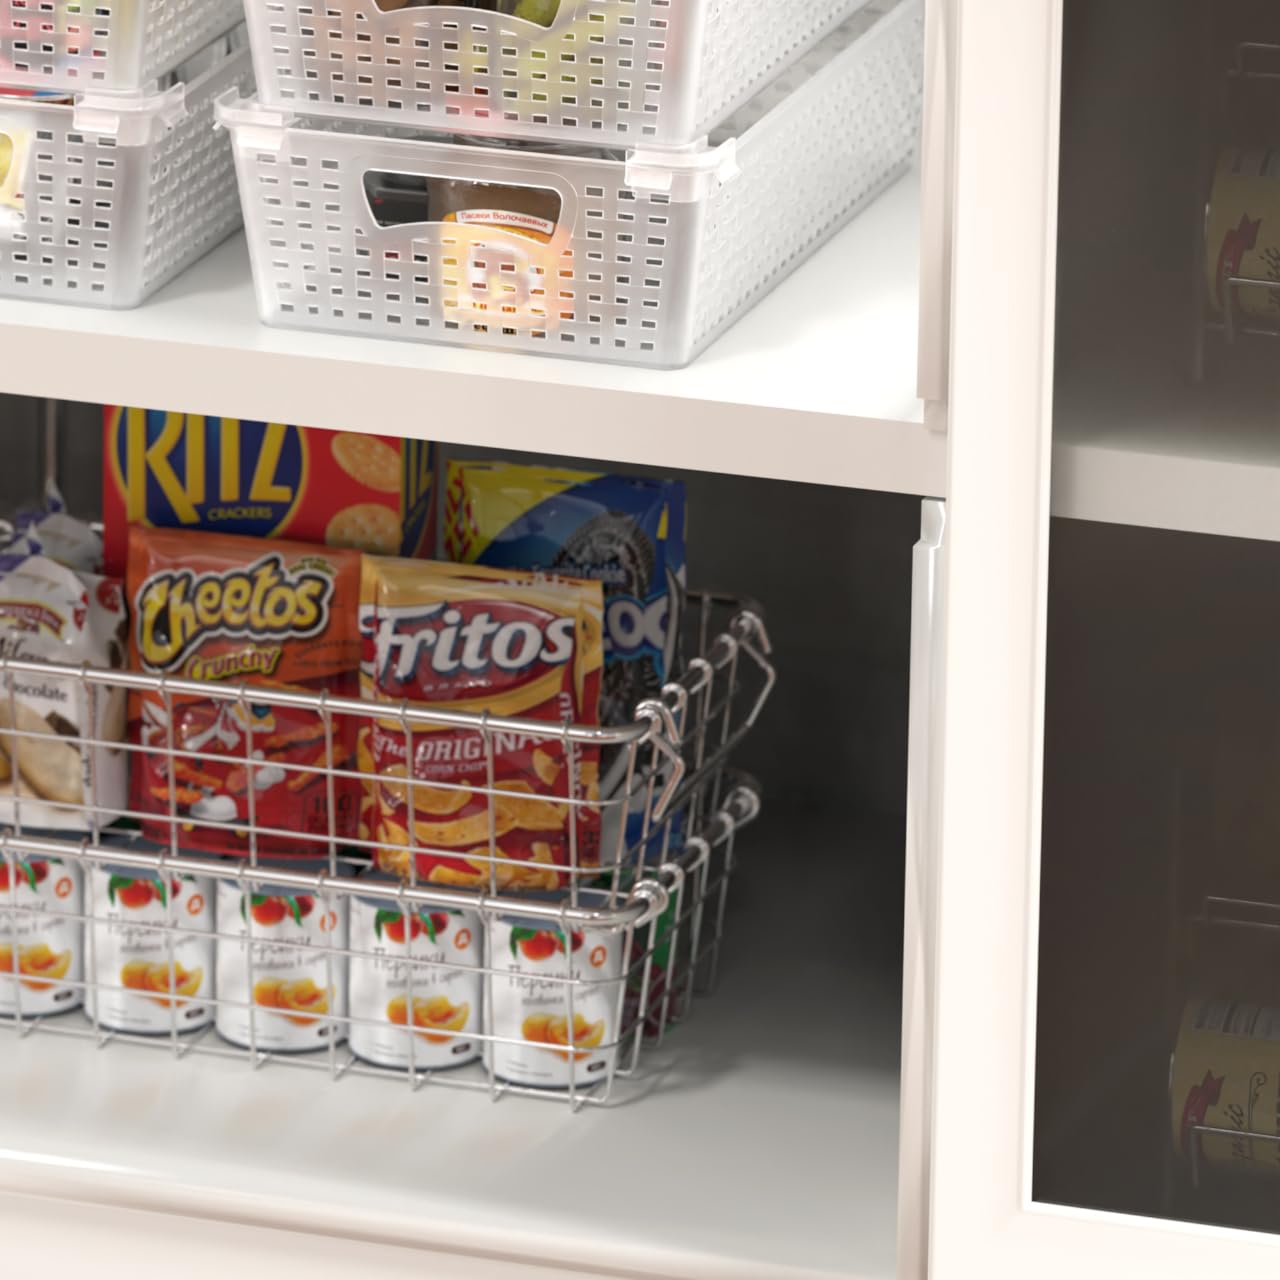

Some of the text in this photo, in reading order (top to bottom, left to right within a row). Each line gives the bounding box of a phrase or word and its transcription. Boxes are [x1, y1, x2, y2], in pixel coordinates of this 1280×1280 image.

[127, 408, 293, 524] RITZ
[207, 506, 273, 521] CRACKERS
[141, 557, 329, 667] Cheetos
[360, 603, 576, 684] Fritos
[186, 646, 281, 680] Crunchy
